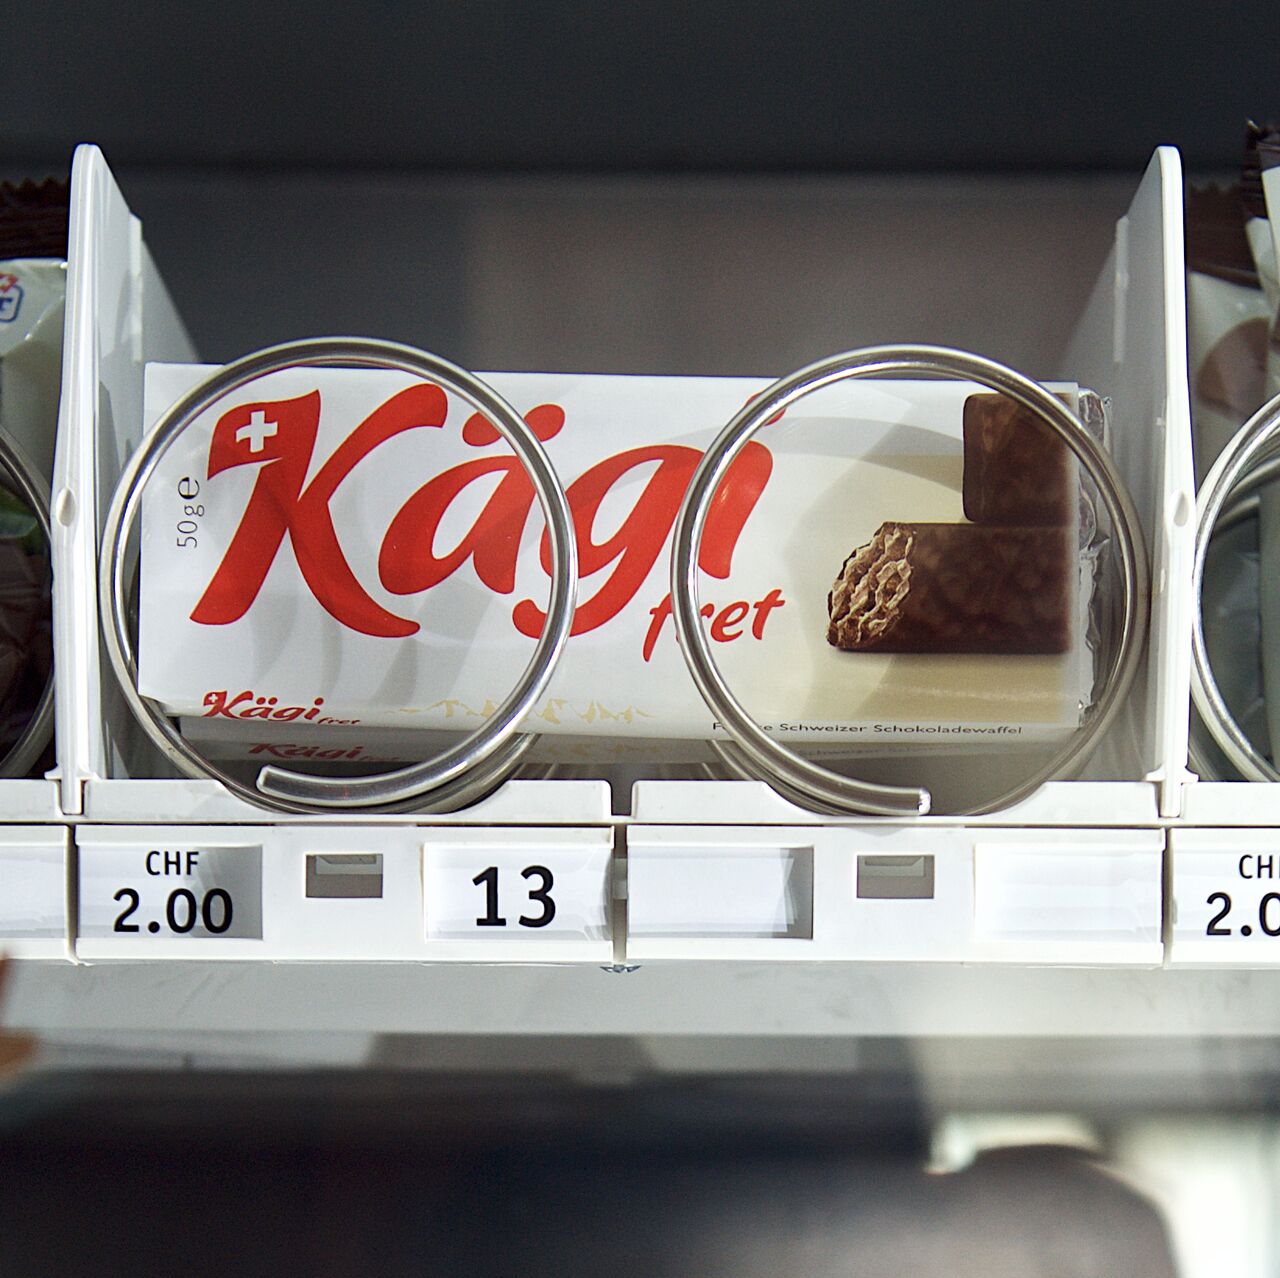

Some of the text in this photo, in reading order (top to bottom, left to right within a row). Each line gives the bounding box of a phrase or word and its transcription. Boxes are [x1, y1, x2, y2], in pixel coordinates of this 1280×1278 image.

[176, 503, 206, 548] 50g
[189, 383, 787, 639] Kägi
[202, 690, 325, 723] Kägi
[779, 723, 868, 733] Schweizer
[873, 724, 1022, 735] Schokoladewaffel
[145, 851, 199, 876] CHF
[113, 888, 233, 934] 2.00
[472, 864, 557, 929] 13
